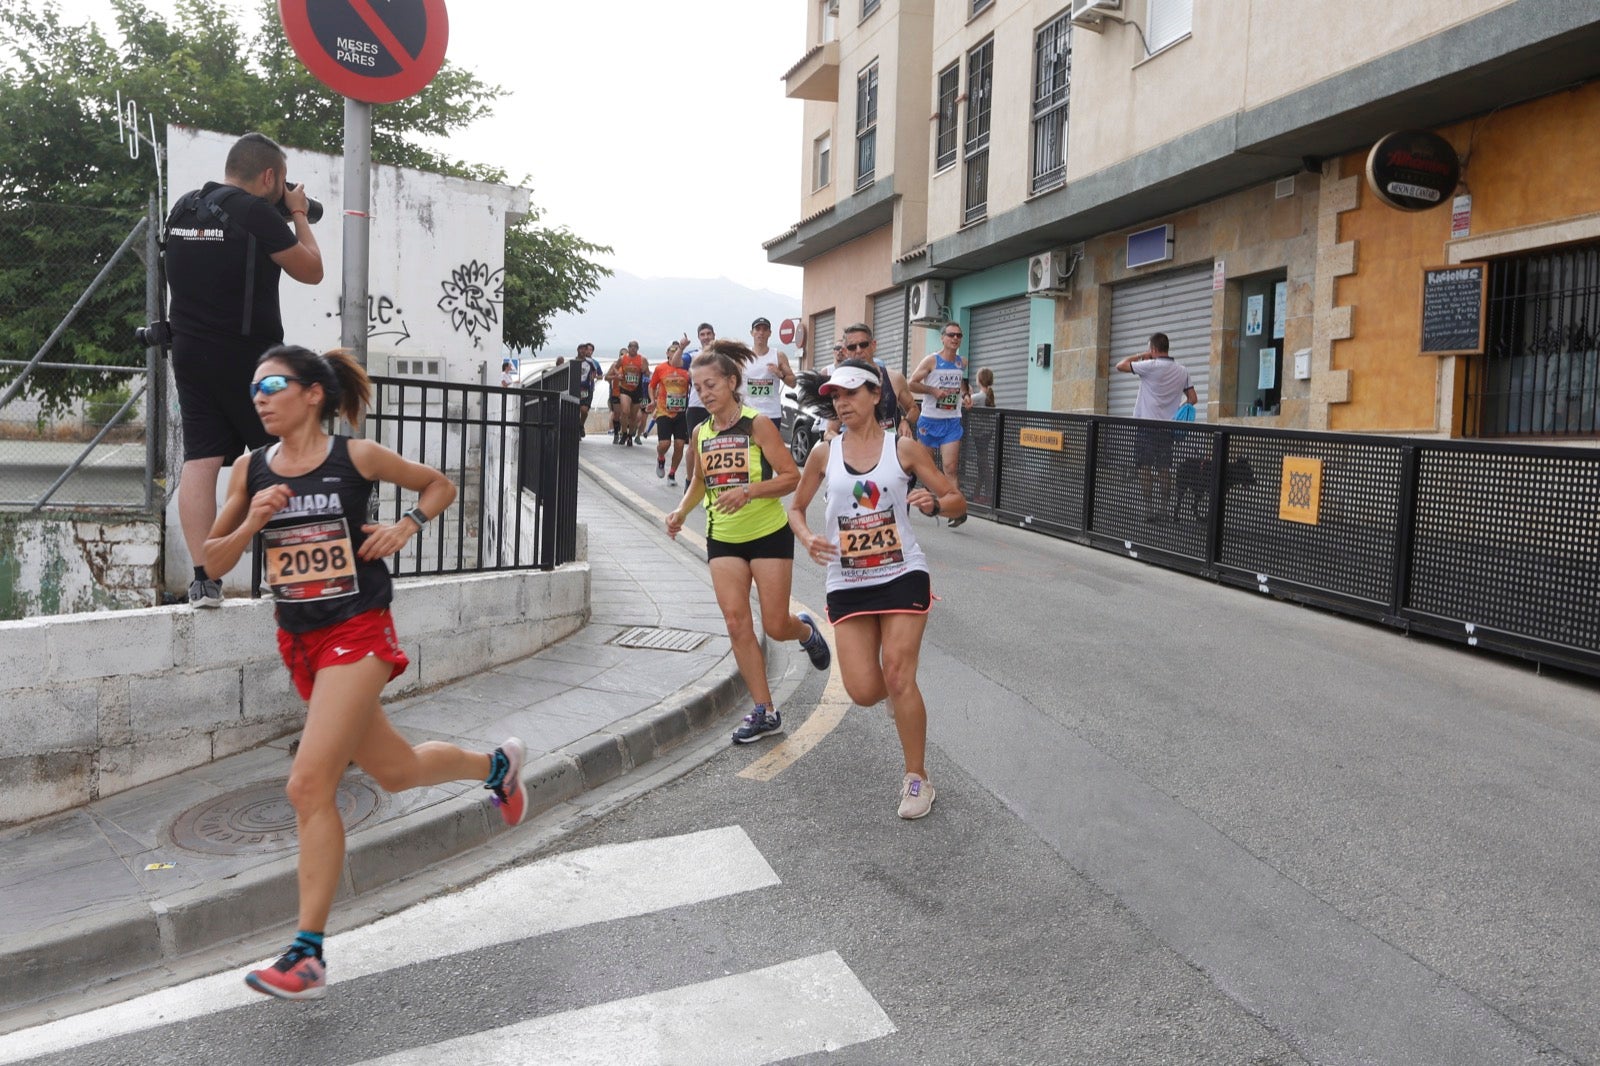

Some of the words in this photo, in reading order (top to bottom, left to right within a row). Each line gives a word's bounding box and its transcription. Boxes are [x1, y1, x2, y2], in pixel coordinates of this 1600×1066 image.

[336, 36, 378, 55] MESES
[336, 50, 375, 67] PARES
[751, 386, 770, 395] 273
[706, 452, 746, 471] 2255
[281, 492, 342, 512] NADA
[847, 528, 897, 552] 2243
[279, 545, 347, 577] 2098
